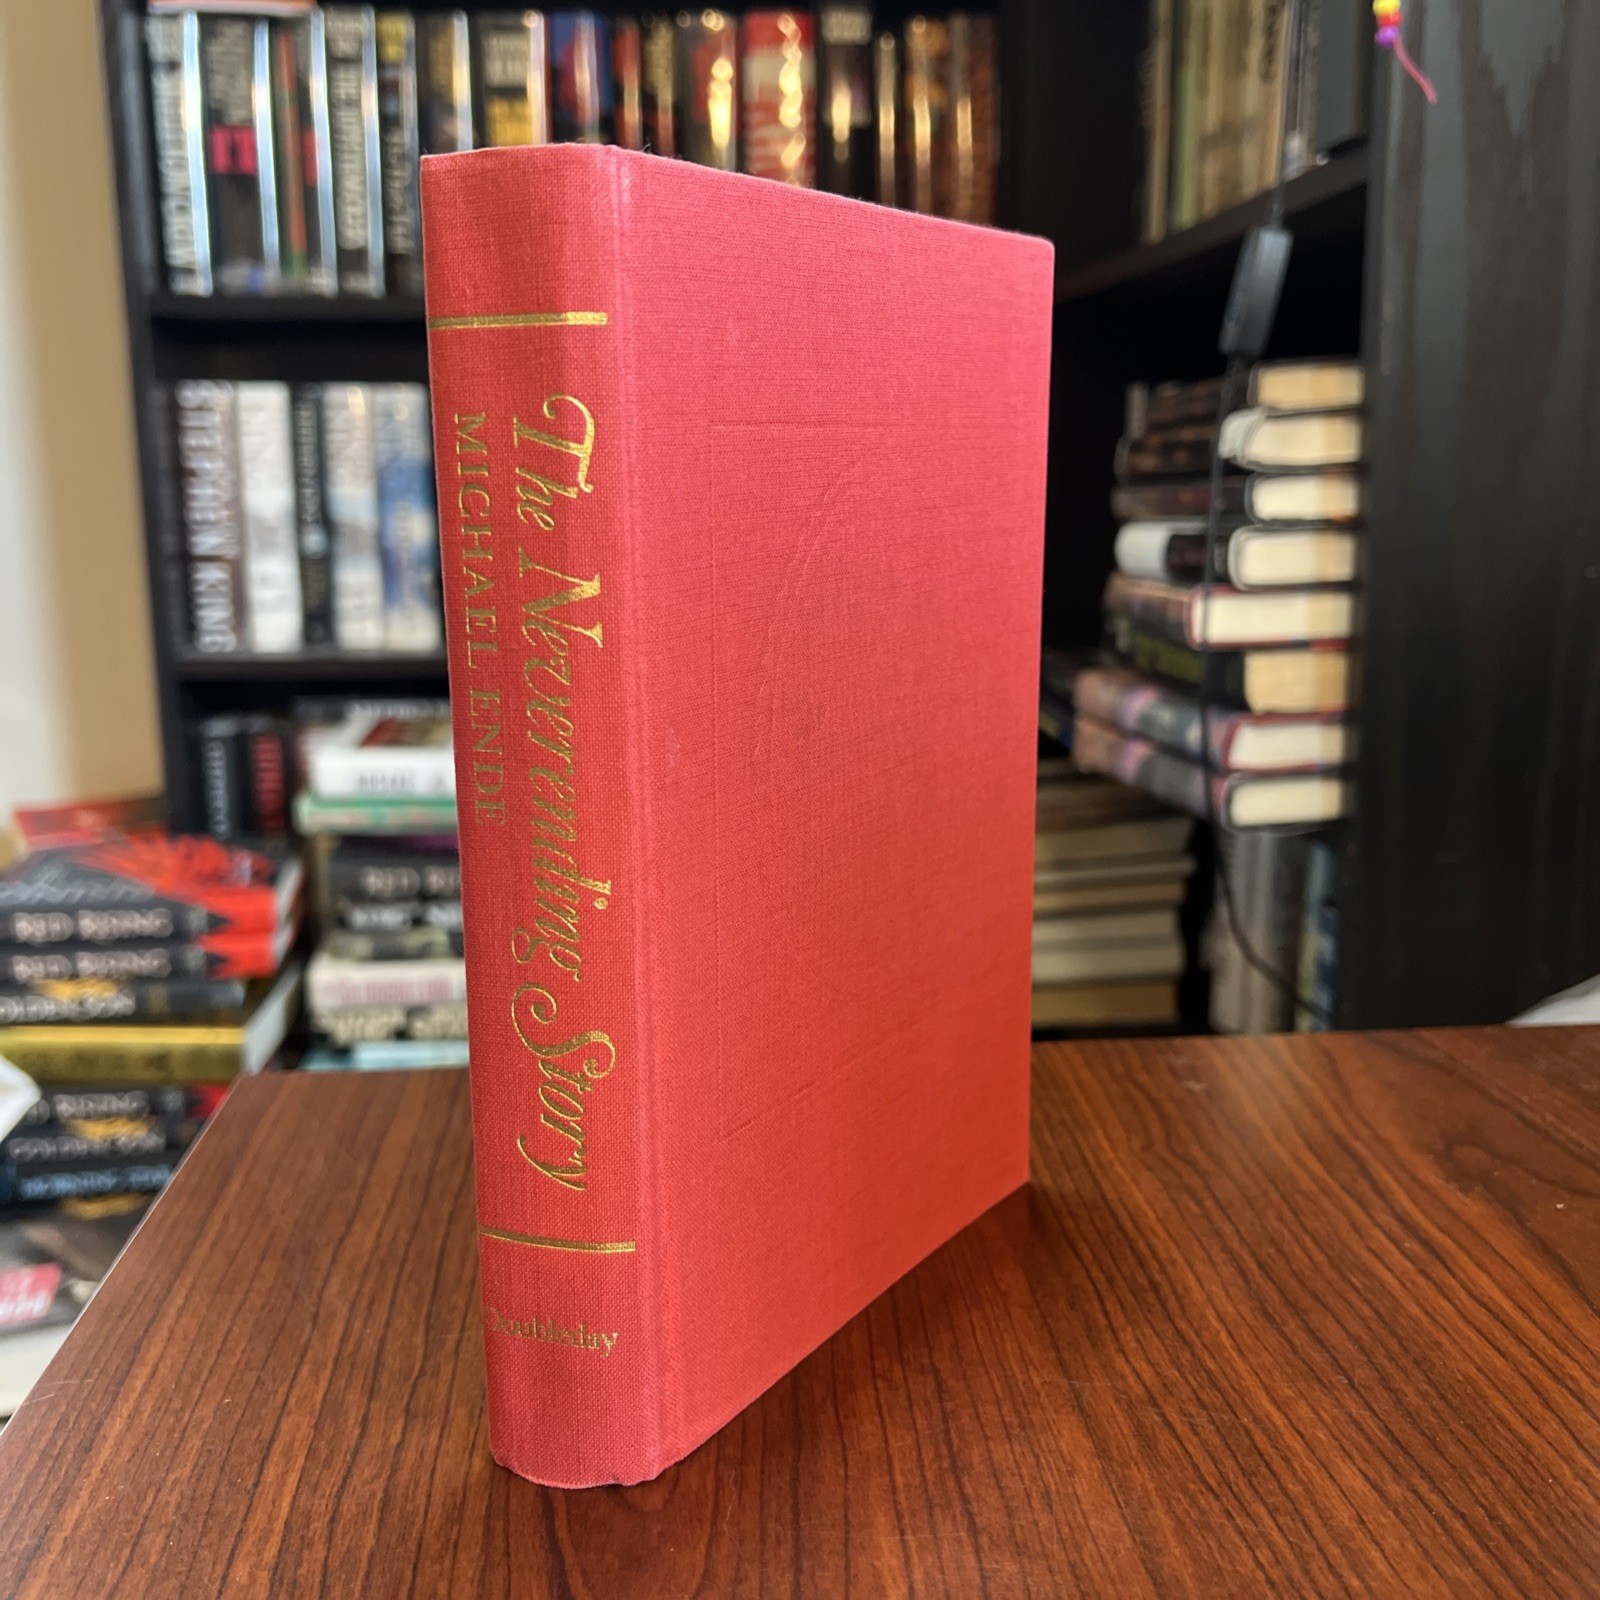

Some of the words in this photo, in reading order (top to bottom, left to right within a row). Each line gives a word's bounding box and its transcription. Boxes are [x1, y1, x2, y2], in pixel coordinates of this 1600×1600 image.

[454, 411, 498, 669] MICHAEL
[513, 393, 596, 531] The
[469, 690, 506, 826] ENDE
[511, 547, 612, 981] Neverending
[512, 982, 616, 1191] Story
